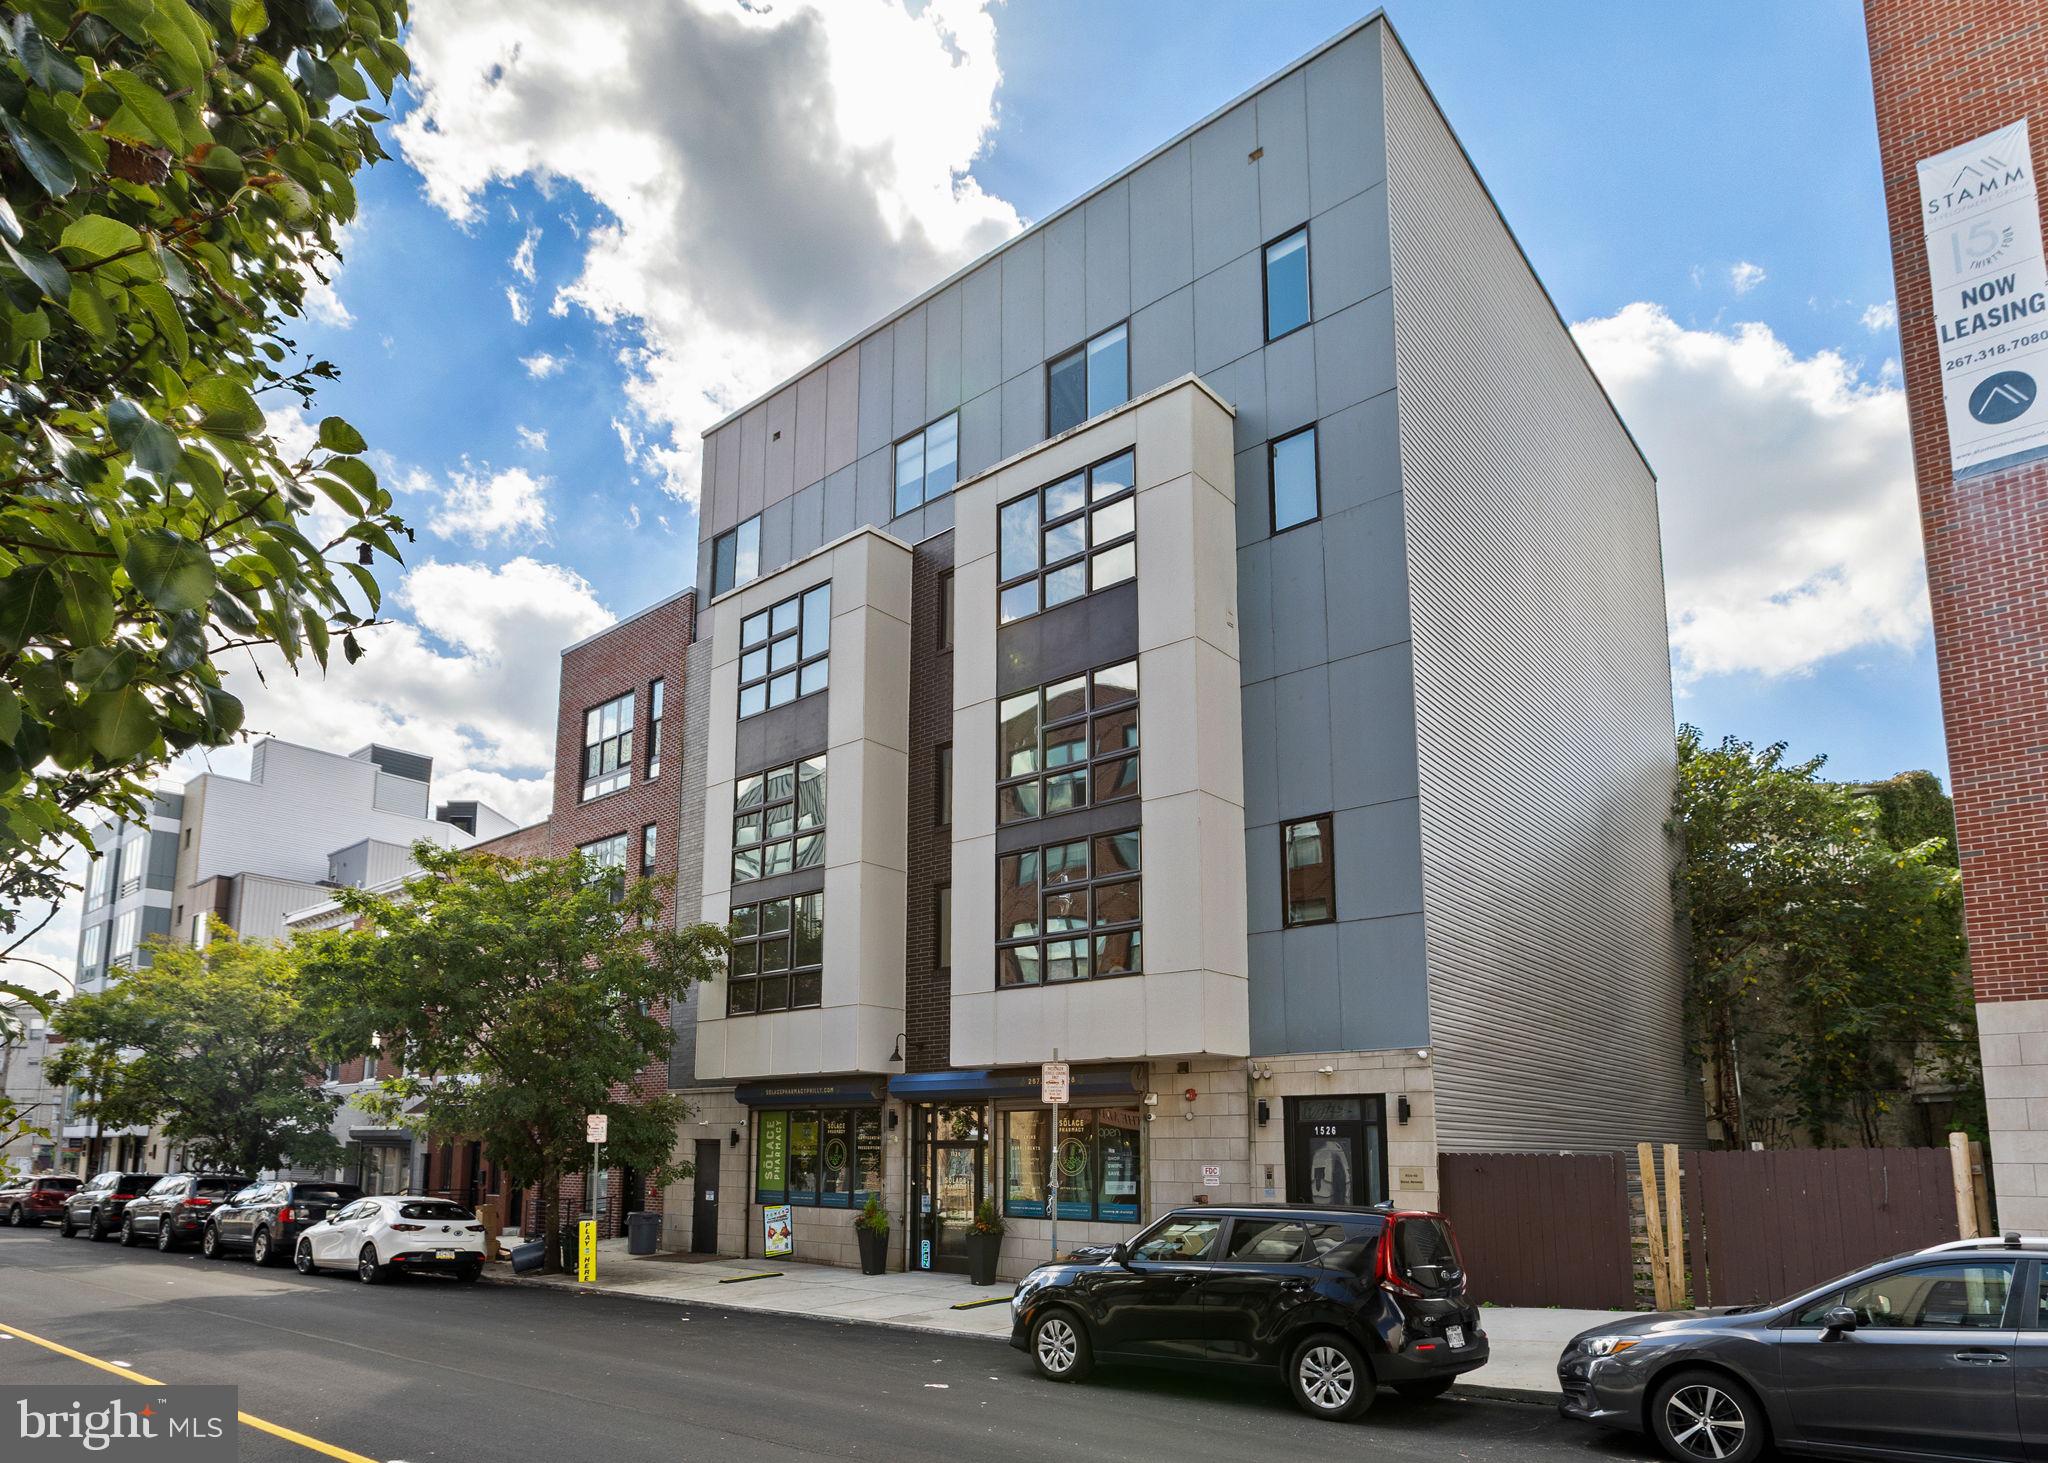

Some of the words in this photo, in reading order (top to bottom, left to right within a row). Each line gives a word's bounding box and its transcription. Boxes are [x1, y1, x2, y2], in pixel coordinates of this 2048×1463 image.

[1928, 167, 2024, 214] STAMM
[1961, 273, 2015, 309] NOW
[1941, 293, 2046, 343] LEASING
[1946, 330, 2048, 371] 267.318.7080
[773, 1120, 782, 1180] PHARMACY
[1314, 1126, 1337, 1136] 1526
[1204, 1167, 1218, 1175] FDC
[583, 1257, 592, 1282] HERE
